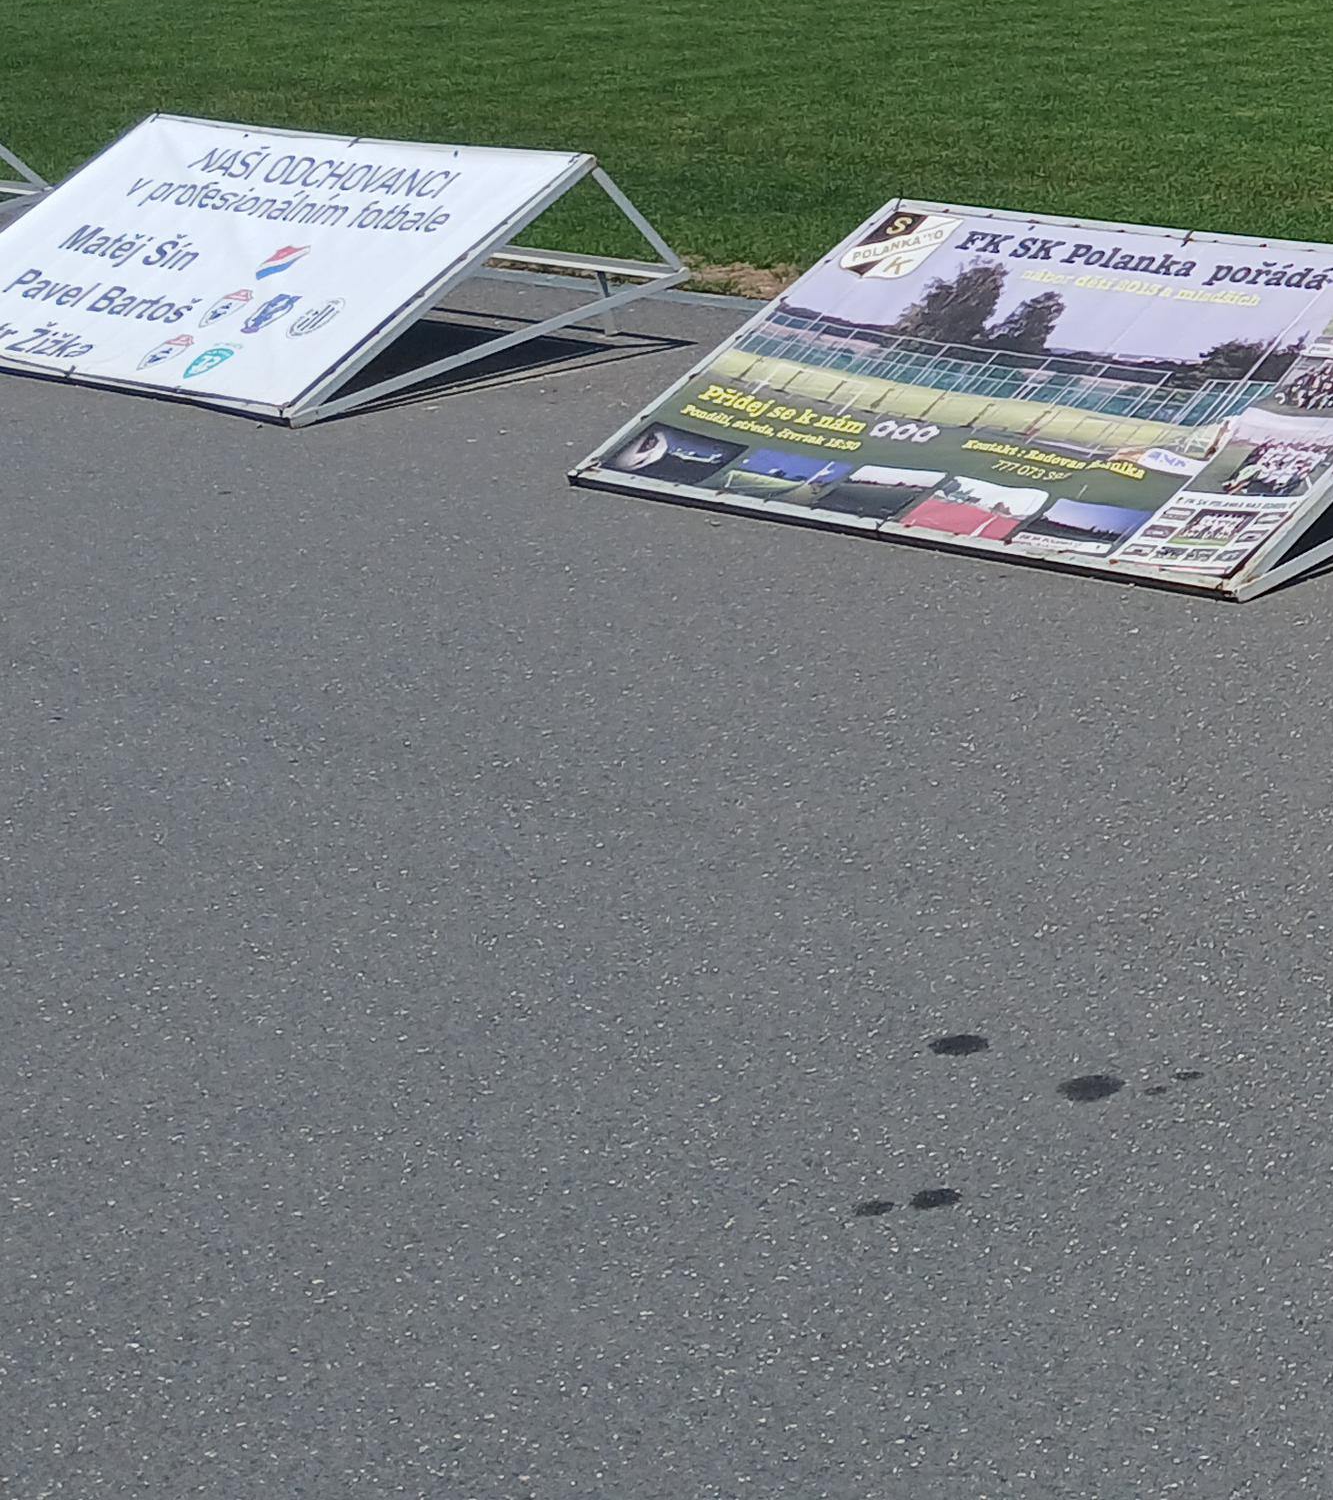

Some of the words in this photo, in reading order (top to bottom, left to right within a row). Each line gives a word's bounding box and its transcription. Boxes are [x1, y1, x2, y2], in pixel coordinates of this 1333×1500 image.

[126, 177, 150, 197] v
[188, 146, 271, 180] NAŠI
[263, 155, 462, 199] ODCHOVANCI
[137, 182, 349, 228] profesionálním
[347, 201, 451, 234] fotbale
[886, 216, 913, 235] S
[58, 225, 154, 268] Matěj
[143, 234, 199, 271] Šín
[853, 235, 921, 262] POLANKA
[955, 230, 1014, 254] FK
[1009, 237, 1066, 261] SK
[1060, 243, 1197, 277] Polanka
[883, 257, 914, 275] K
[3, 268, 102, 307] Pavel
[86, 286, 203, 323] Bartoš
[5, 321, 94, 358] Žižka
[698, 384, 776, 418] Přidej
[767, 400, 798, 422] se
[794, 408, 816, 426] k
[818, 414, 867, 436] nám
[962, 439, 1017, 457] Kontakt
[1024, 449, 1086, 471] Radovan
[992, 459, 1019, 472] 777
[1016, 464, 1045, 479] 073
